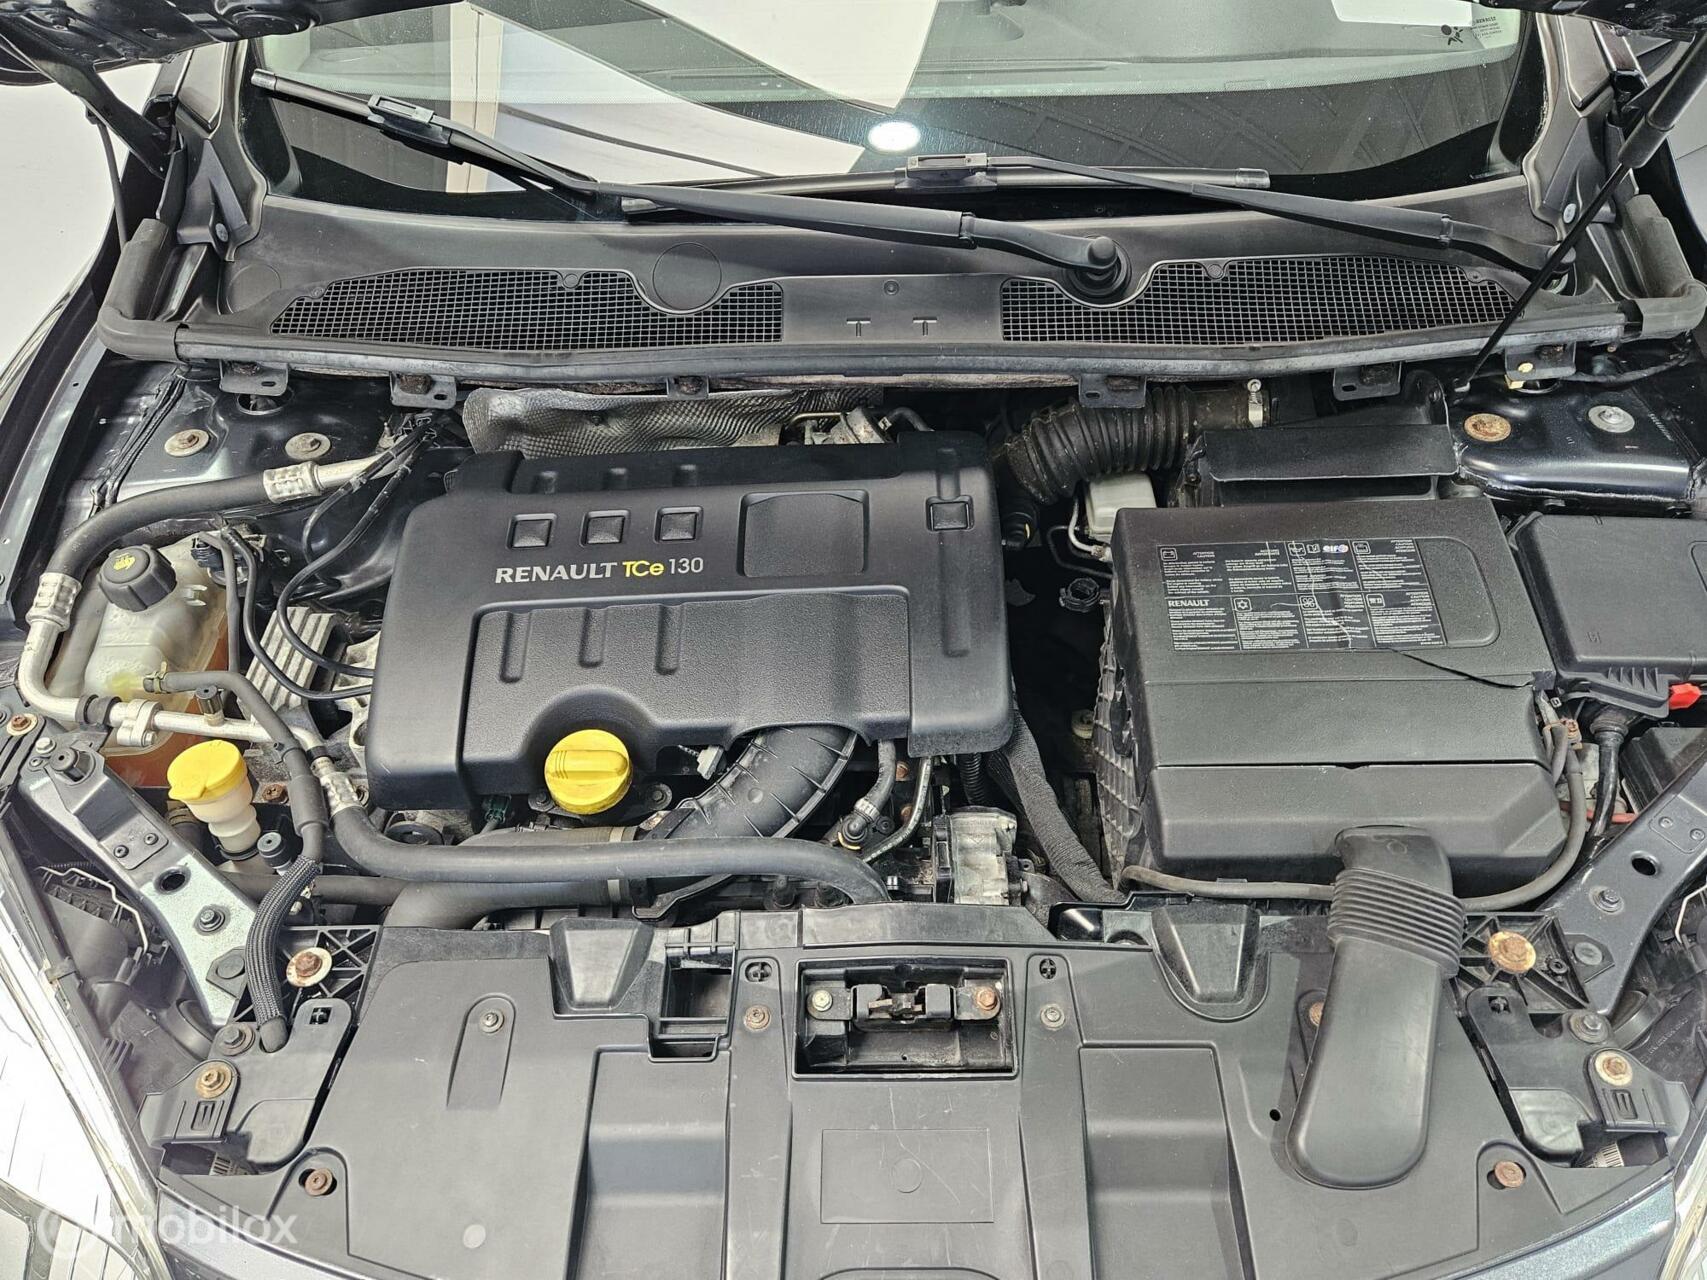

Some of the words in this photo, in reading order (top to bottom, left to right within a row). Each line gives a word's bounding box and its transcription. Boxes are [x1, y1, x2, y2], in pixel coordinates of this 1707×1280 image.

[495, 562, 618, 584] RENAULT
[622, 560, 665, 578] TCe
[669, 557, 704, 575] 130
[1168, 599, 1210, 607] RENAULT
